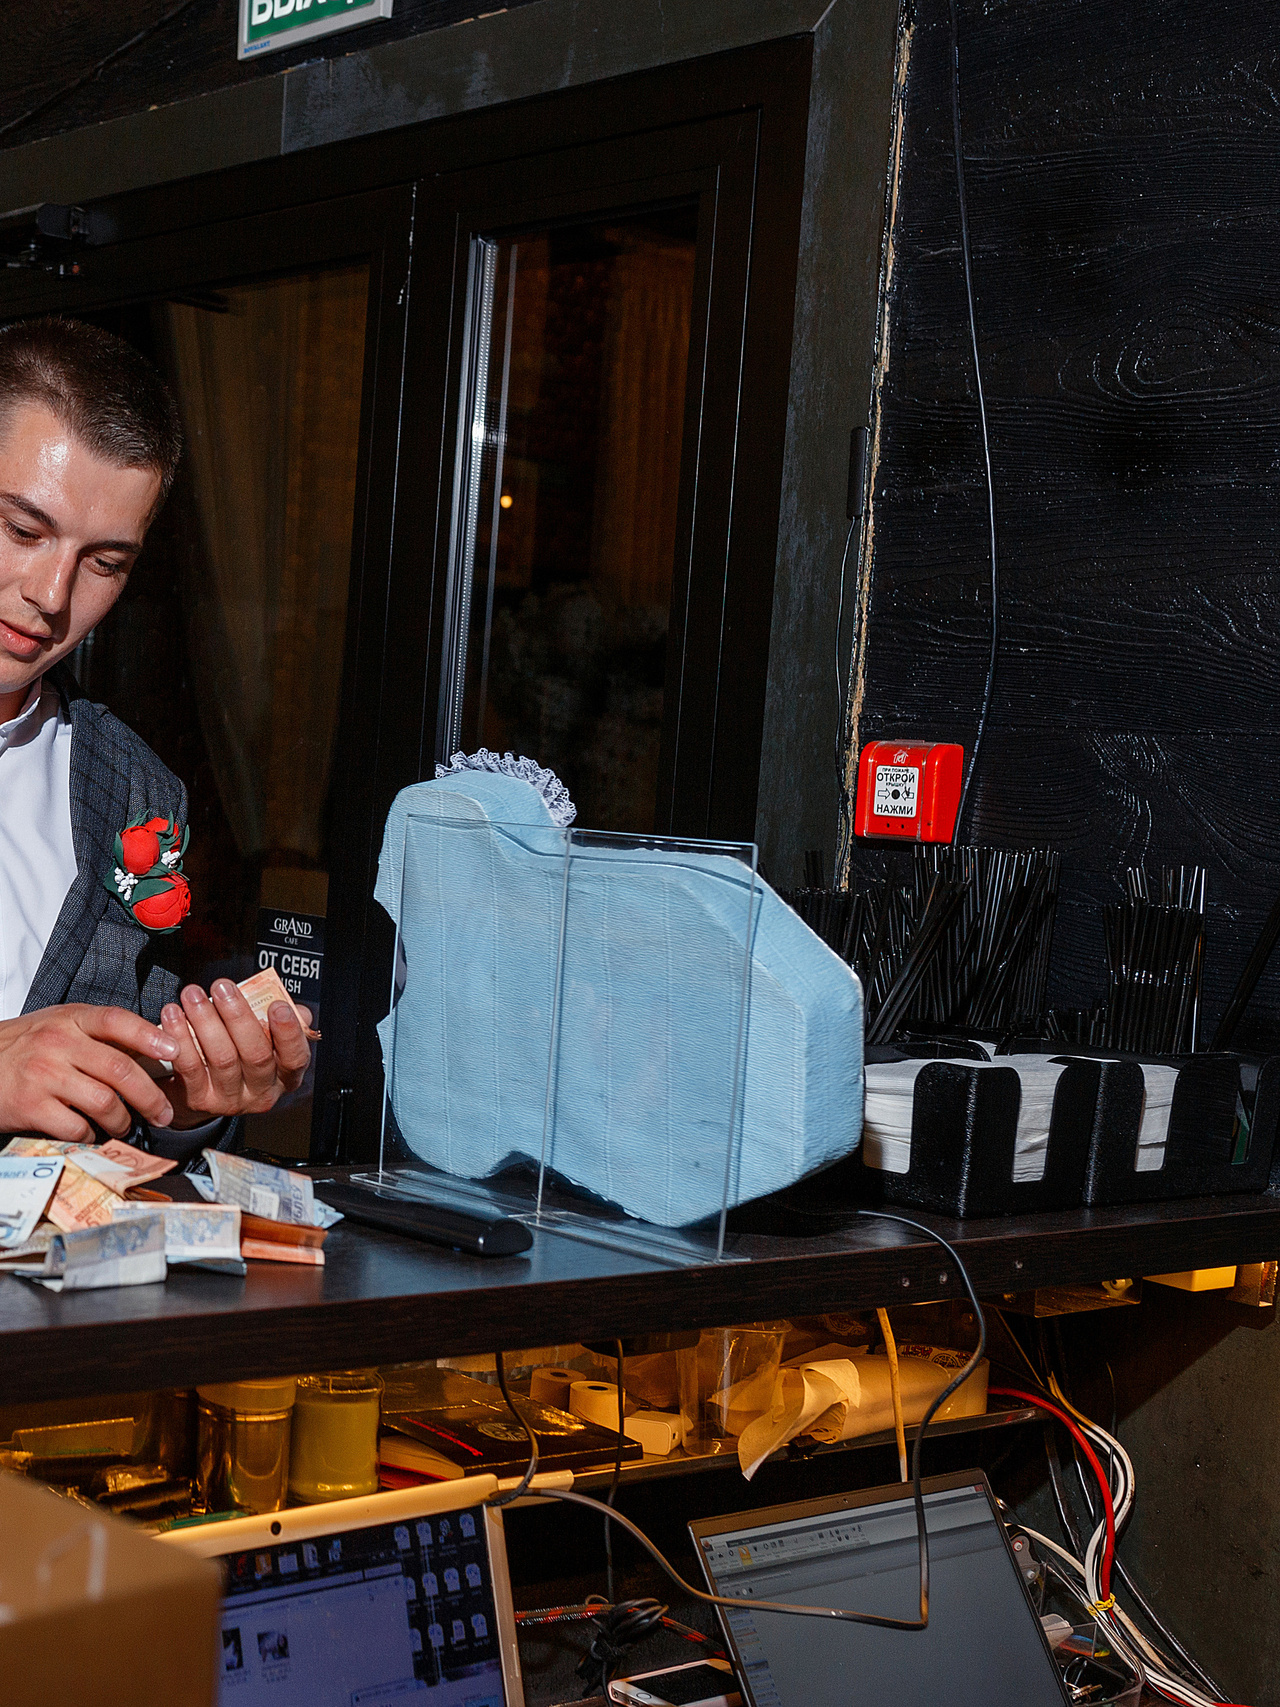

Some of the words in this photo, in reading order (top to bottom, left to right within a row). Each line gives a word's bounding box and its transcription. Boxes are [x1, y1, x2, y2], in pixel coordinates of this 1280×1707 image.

[876, 772, 915, 783] ОТКРОЙ
[876, 804, 913, 815] НАЖМИ
[273, 917, 312, 936] GRAND
[284, 936, 298, 945] CAFE
[258, 950, 278, 969] ОТ
[281, 954, 320, 979] СЕБЯ
[281, 977, 301, 994] USH
[33, 1161, 57, 1178] 10
